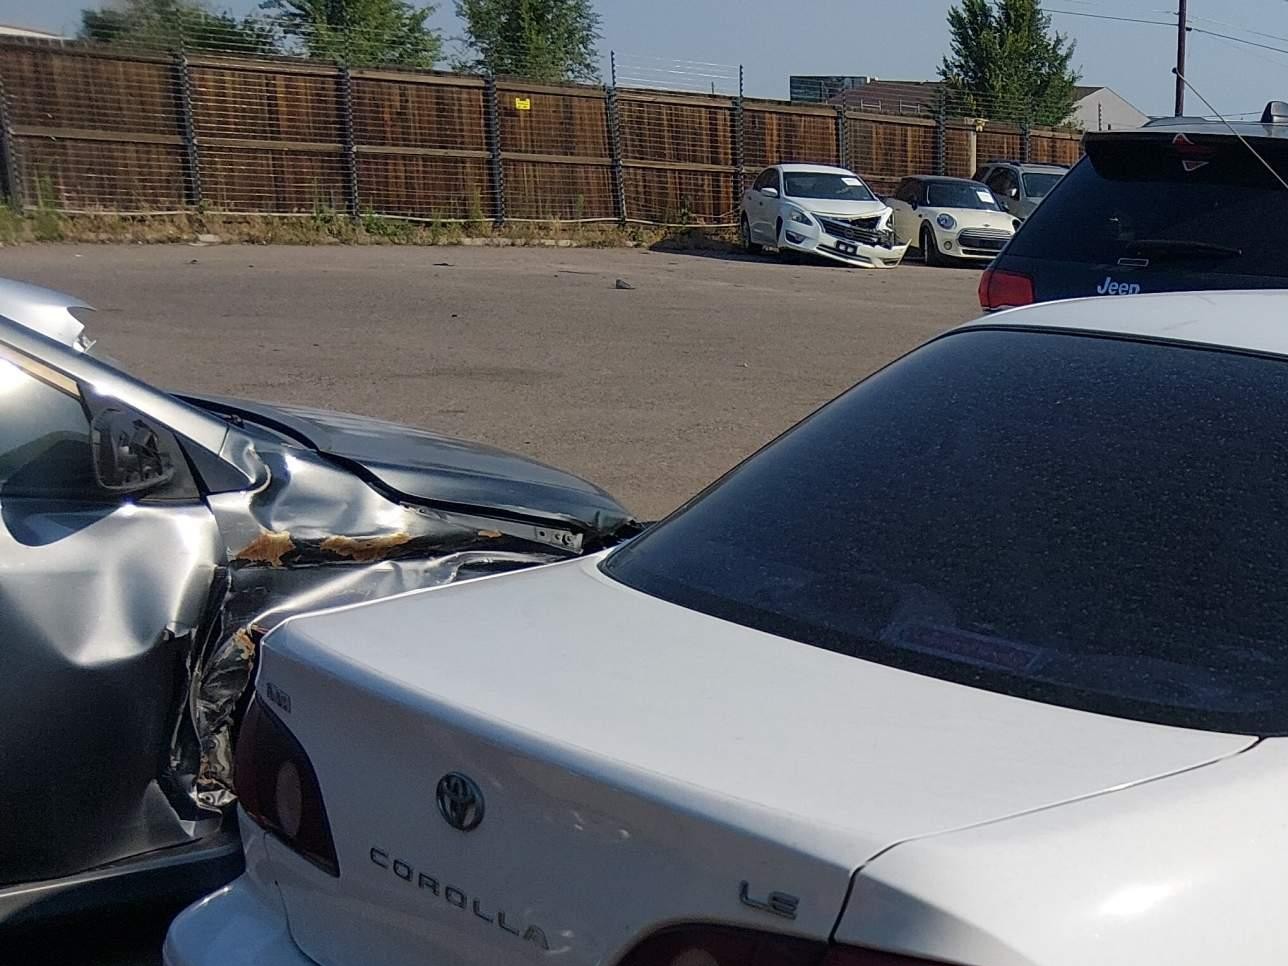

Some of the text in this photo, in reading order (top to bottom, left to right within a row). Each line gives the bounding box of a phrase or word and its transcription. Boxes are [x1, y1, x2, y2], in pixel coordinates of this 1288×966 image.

[1096, 276, 1140, 295] Jeep
[370, 847, 549, 950] COROLLA
[739, 880, 800, 920] LE
